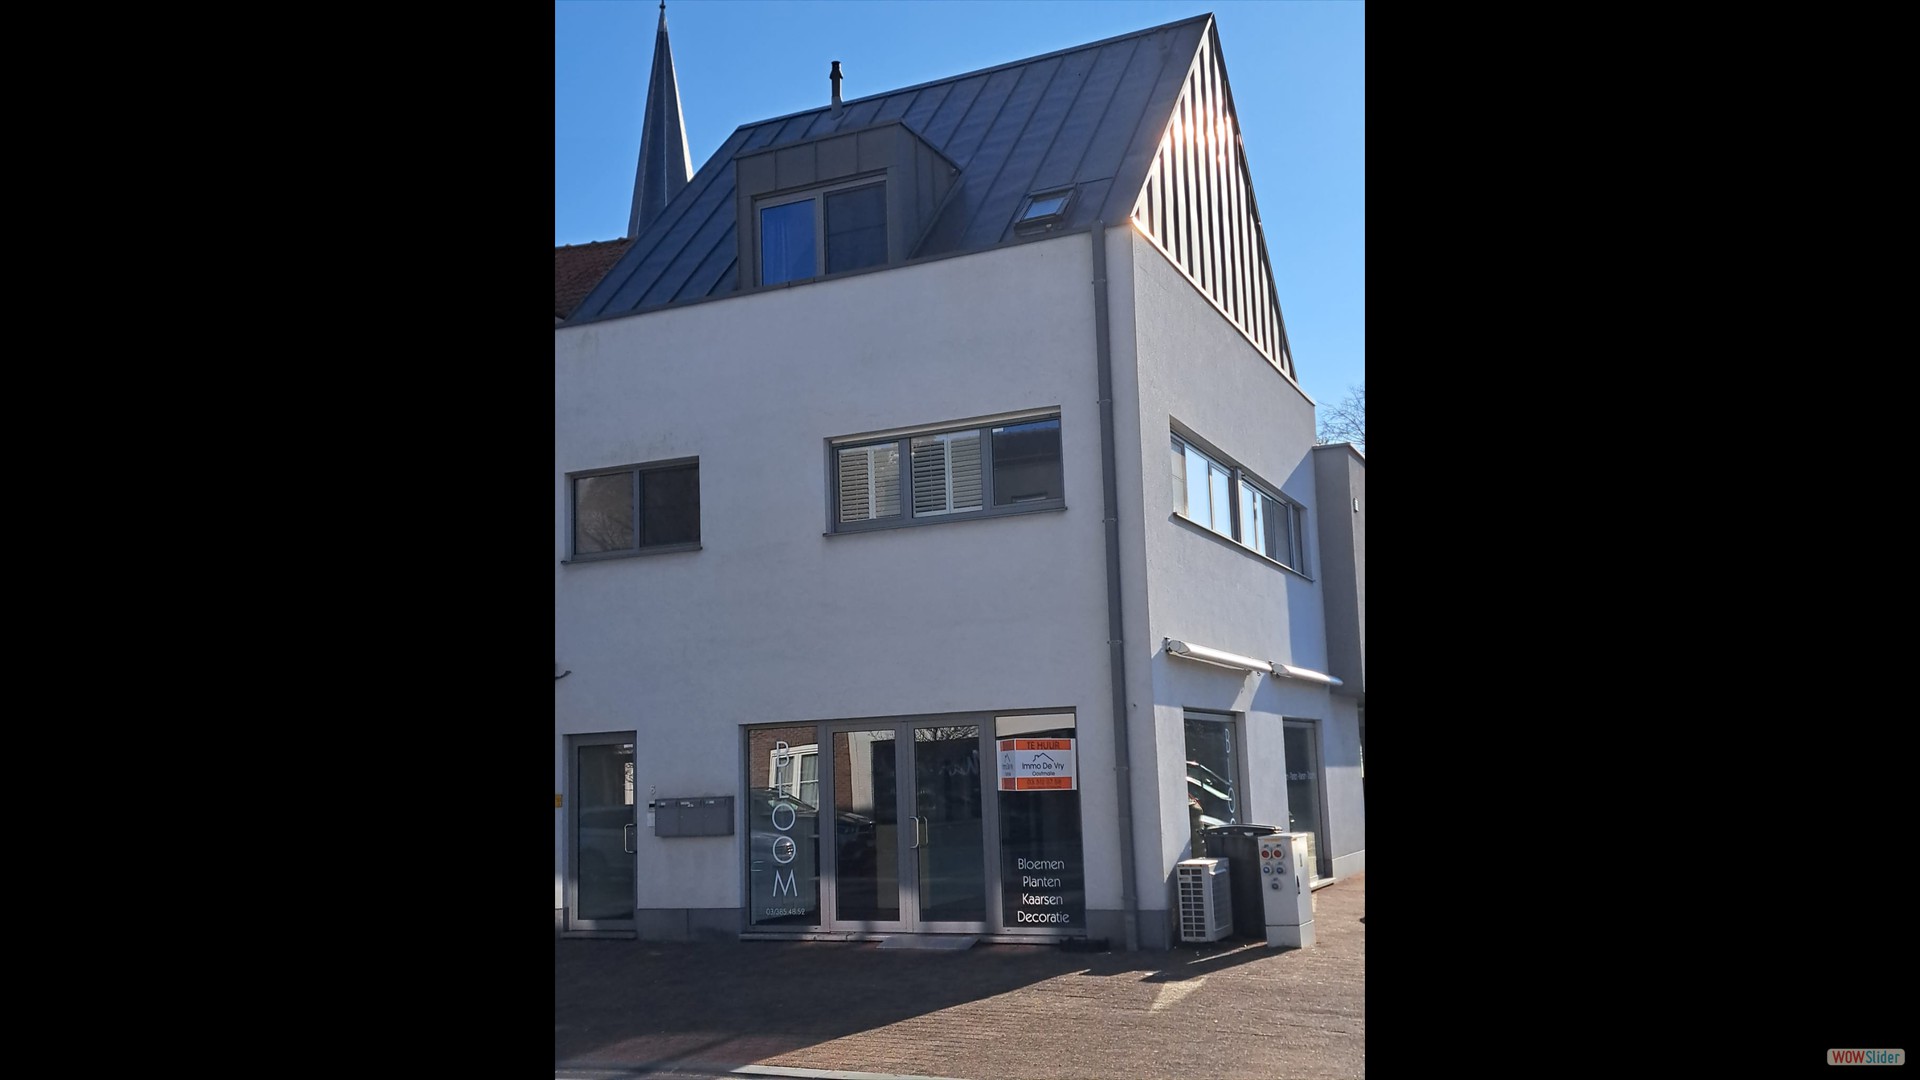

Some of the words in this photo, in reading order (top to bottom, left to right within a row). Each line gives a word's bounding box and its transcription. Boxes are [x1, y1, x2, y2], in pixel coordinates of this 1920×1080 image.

[1026, 741, 1035, 750] TE
[1037, 741, 1061, 750] HUUR
[1021, 762, 1042, 770] Immo
[1042, 762, 1053, 770] De
[1053, 762, 1065, 771] Vry
[771, 741, 798, 897] BLOOM
[1017, 857, 1065, 870] Bloemen
[1022, 875, 1061, 888] Planten
[1022, 892, 1063, 905] Kaarsen
[1017, 910, 1070, 923] Decoratie
